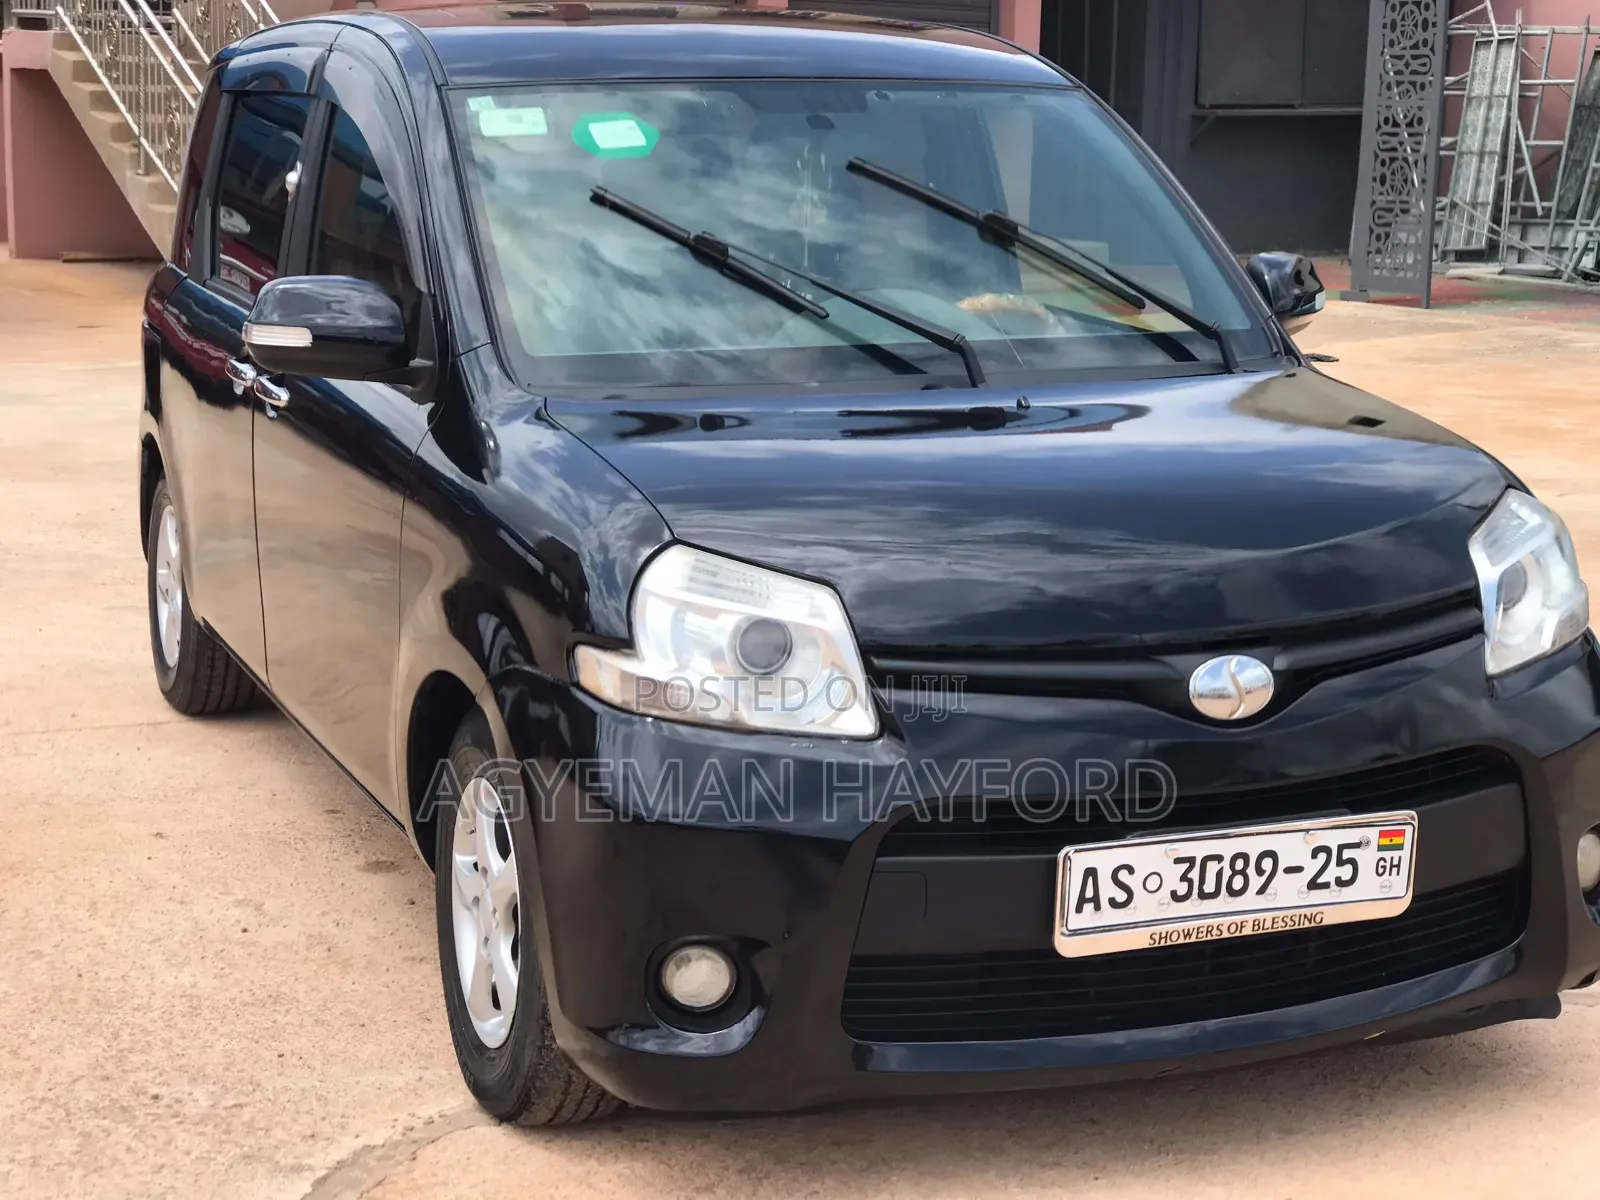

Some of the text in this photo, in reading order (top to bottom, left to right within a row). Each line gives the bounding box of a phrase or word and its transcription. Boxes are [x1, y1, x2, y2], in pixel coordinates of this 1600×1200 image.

[1074, 841, 1364, 915] AS 3089-25
[1375, 855, 1402, 878] GH
[1148, 910, 1325, 947] SHOWERS OF BLESSING
